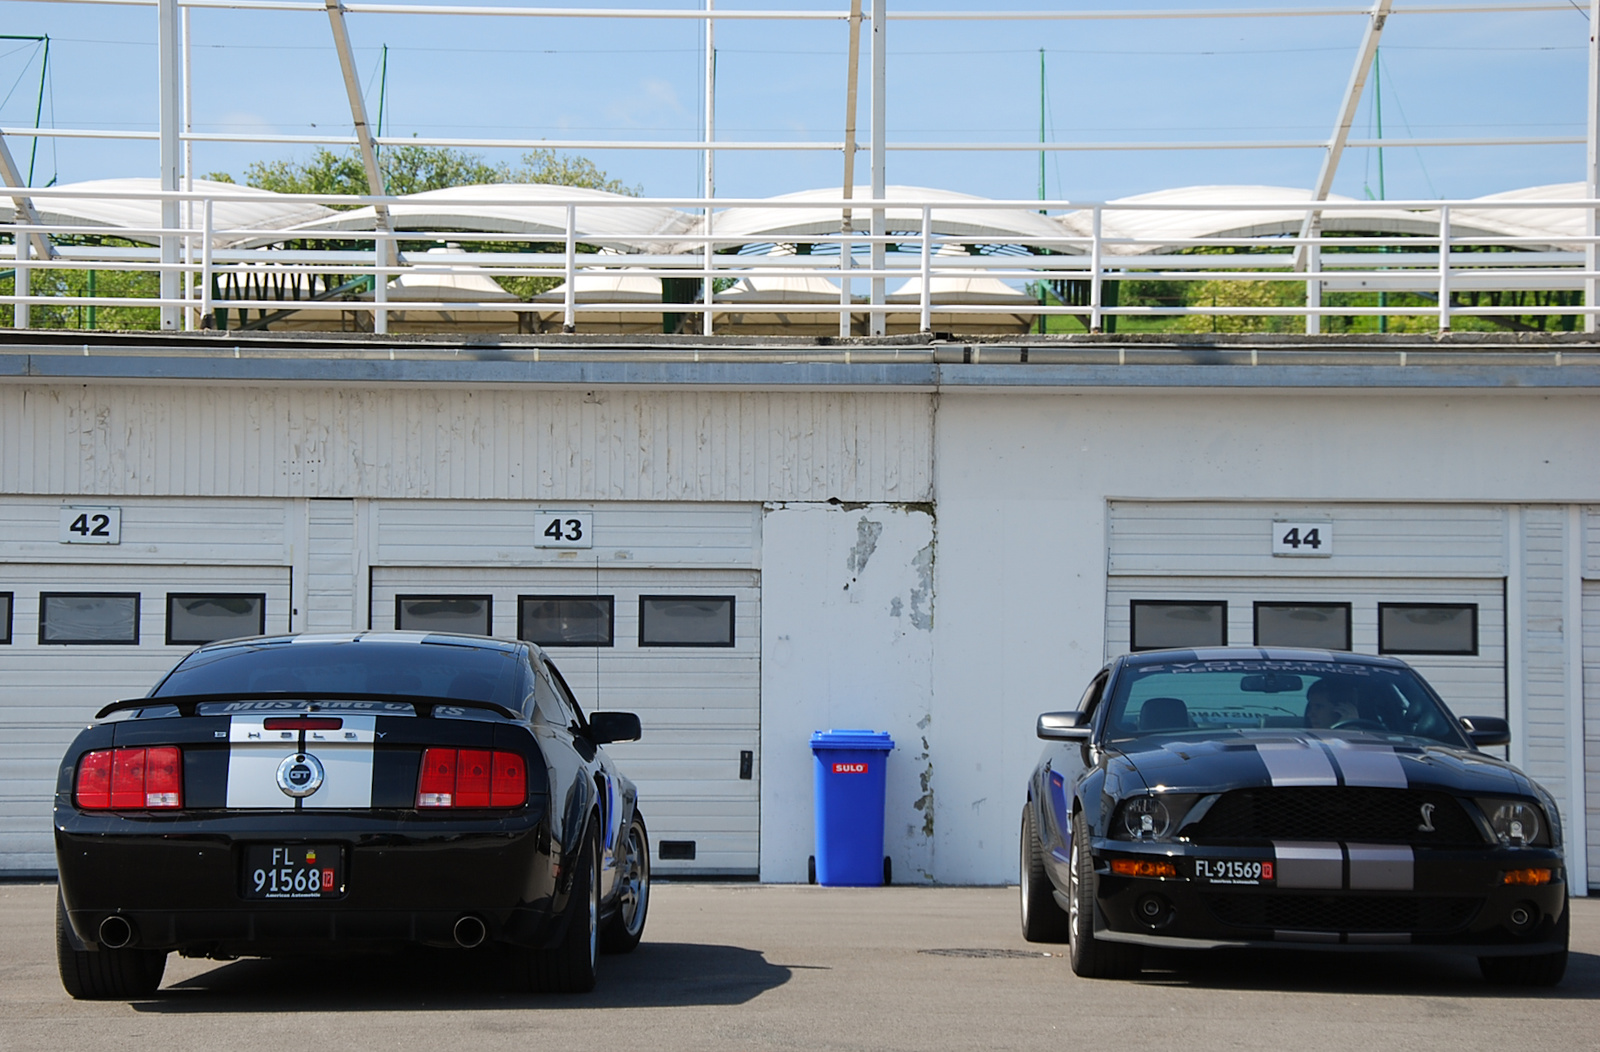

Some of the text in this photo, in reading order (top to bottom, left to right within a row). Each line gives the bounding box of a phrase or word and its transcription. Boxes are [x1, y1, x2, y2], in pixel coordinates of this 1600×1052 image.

[70, 513, 110, 536] 42
[544, 518, 583, 541] 43
[1282, 527, 1322, 549] 44
[1138, 661, 1400, 676] EVOLUTION
[1172, 665, 1370, 676] PERFORMANCE
[223, 701, 466, 716] MUSTANG CAS
[290, 770, 310, 779] GT
[835, 764, 864, 772] SULO
[272, 848, 294, 866] FL
[253, 868, 321, 892] 91568
